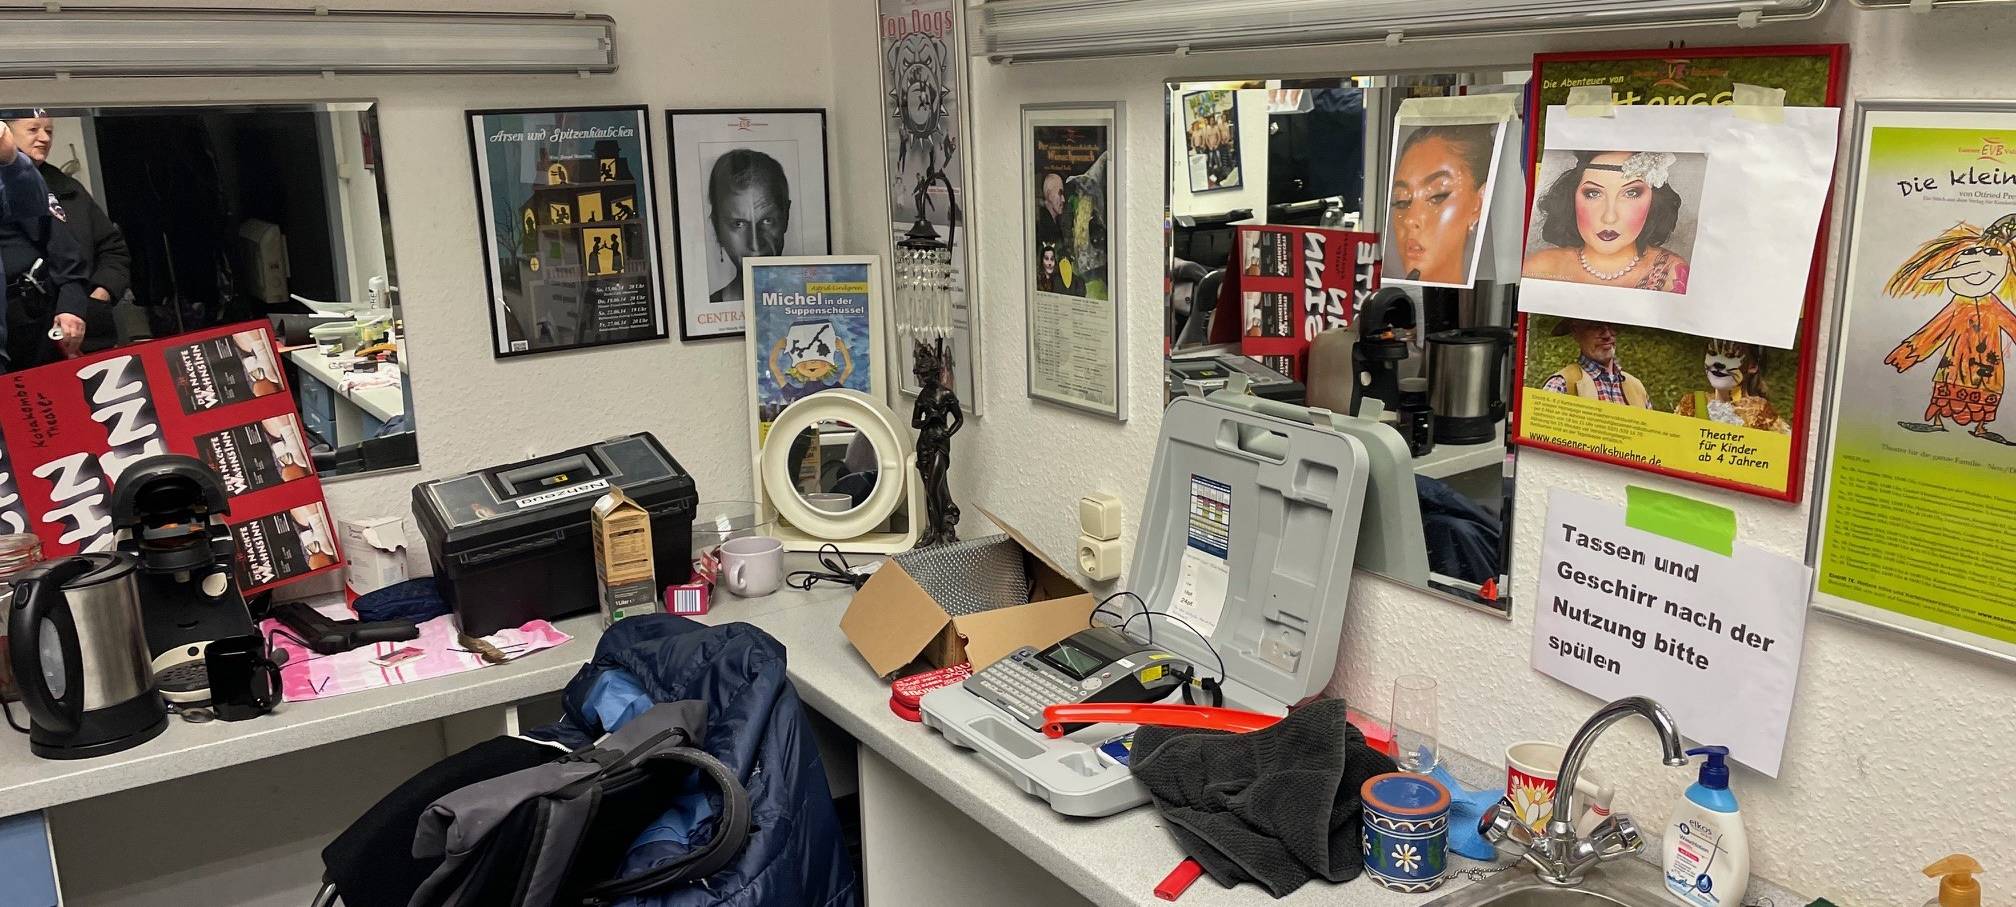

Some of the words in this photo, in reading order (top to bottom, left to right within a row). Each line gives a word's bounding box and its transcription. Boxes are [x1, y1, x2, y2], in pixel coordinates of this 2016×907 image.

[880, 13, 906, 40] Top
[911, 8, 953, 39] Dogs
[1543, 79, 1558, 89] Die
[1560, 75, 1607, 88] Abenteuer
[1609, 75, 1624, 84] von
[490, 128, 523, 143] Arsen
[527, 128, 546, 141] und
[549, 125, 634, 144] Spitzenhäubchen
[1981, 144, 2004, 156] EVB
[1897, 177, 1938, 198] Die
[1974, 190, 2001, 199] Otfried
[762, 292, 822, 306] Michel
[824, 297, 834, 305] in
[836, 297, 853, 305] der
[180, 349, 200, 387] NACKTE
[190, 344, 219, 409] WAHNSINN
[1529, 431, 1662, 467] www.essener-volksbuehne.de
[1698, 440, 1716, 452] für
[1720, 442, 1758, 456] Kinder
[1700, 428, 1745, 443] Theater
[210, 436, 229, 473] NACKTE
[220, 431, 248, 495] WAHNSINN
[1698, 452, 1712, 463] ab
[1716, 452, 1724, 464] 4
[1727, 454, 1770, 470] Jahren
[239, 526, 257, 562] NACKTE
[249, 520, 276, 584] WAHNSINN
[1562, 523, 1646, 566] Tassen
[1654, 555, 1701, 584] und
[1557, 560, 1658, 609] Geschirr
[1663, 598, 1723, 635] nach
[1729, 623, 1775, 653] der
[1552, 595, 1647, 650] Nutzung
[1654, 632, 1710, 671] bitte
[1548, 634, 1622, 676] spülen
[1689, 819, 1712, 836] elkos
